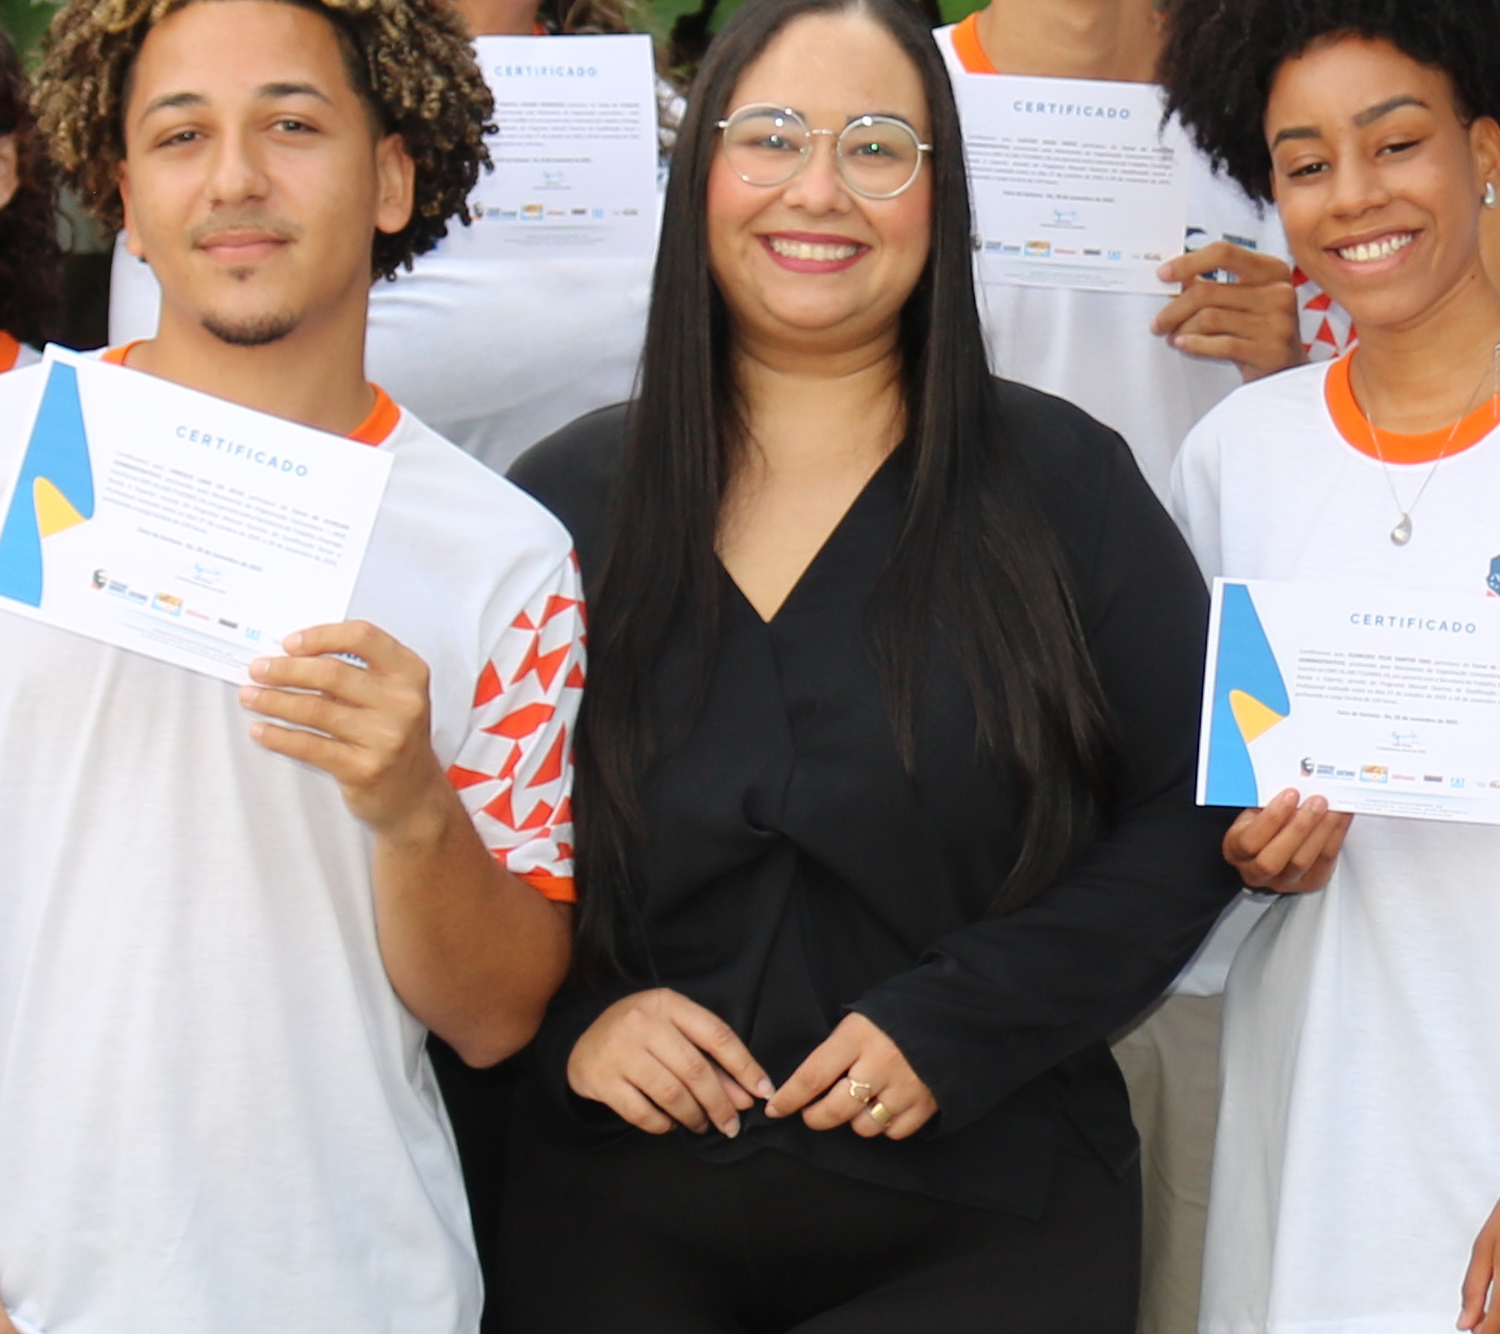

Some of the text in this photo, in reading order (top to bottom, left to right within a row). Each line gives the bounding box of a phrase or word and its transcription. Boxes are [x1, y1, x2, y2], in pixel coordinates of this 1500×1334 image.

[493, 64, 598, 78] CERTIFICADO
[1012, 99, 1132, 121] CERTIFICADO
[175, 423, 310, 479] CERTIFICADO
[1349, 611, 1478, 636] CERTIFICADO
